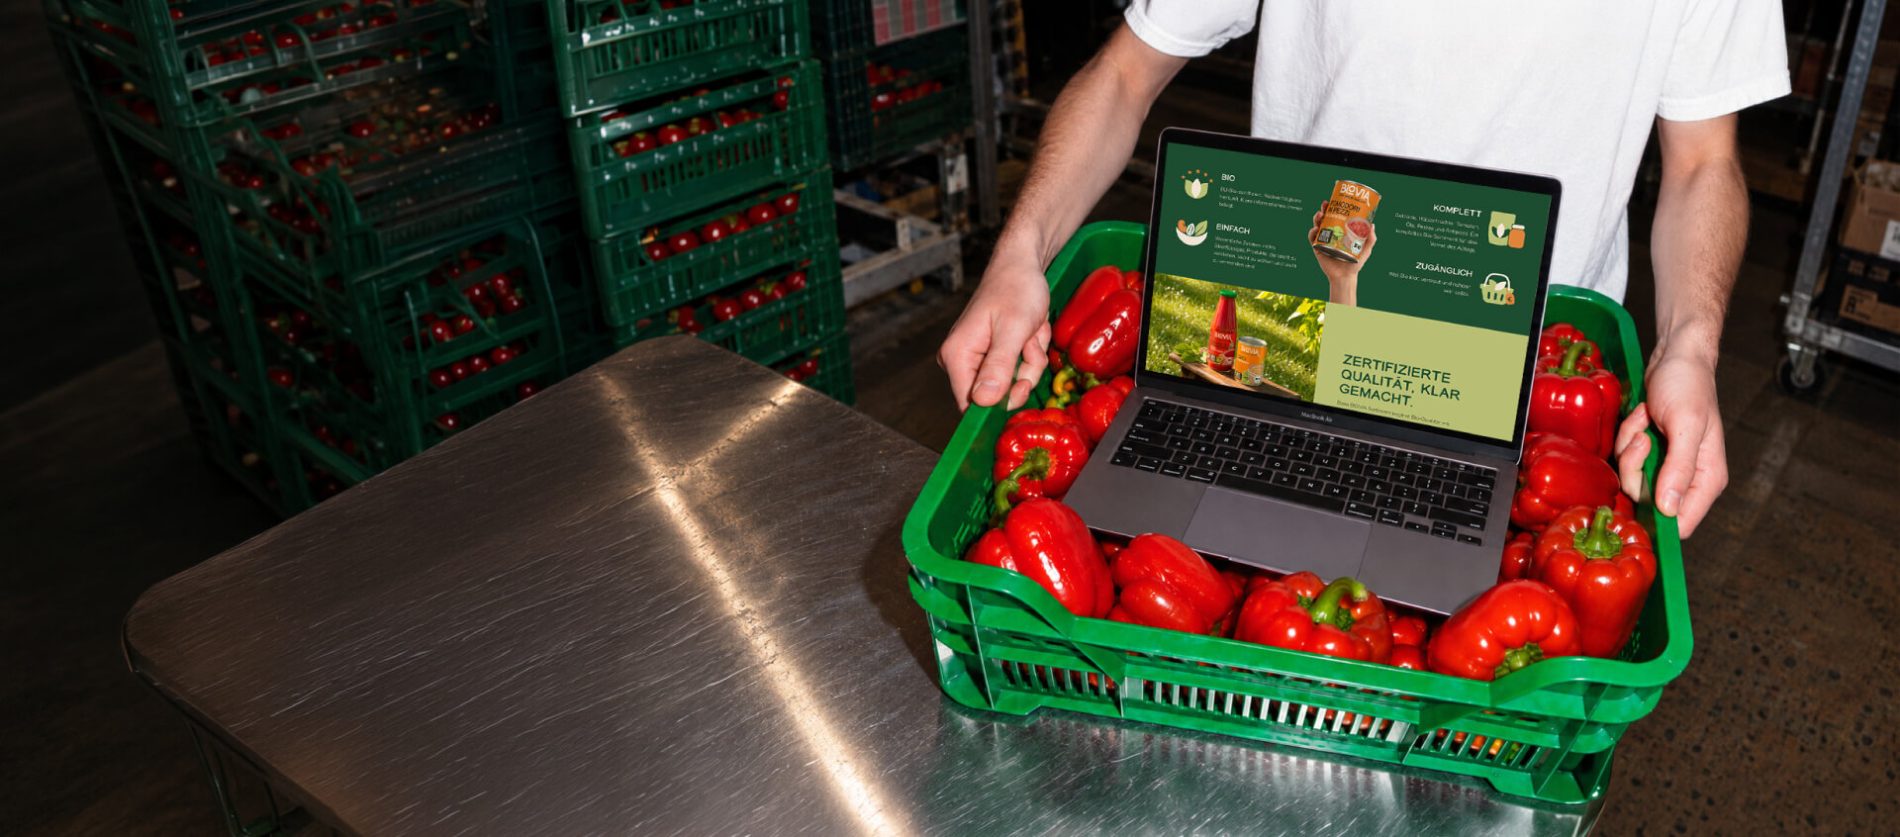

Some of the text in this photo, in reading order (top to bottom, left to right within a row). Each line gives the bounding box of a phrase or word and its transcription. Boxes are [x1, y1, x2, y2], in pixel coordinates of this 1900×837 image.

[1221, 174, 1236, 182] BIO
[1433, 204, 1482, 218] KOMPLETT
[1216, 223, 1250, 234] EINFACH
[1416, 262, 1473, 278] ZUGÄNGLICH
[1342, 354, 1451, 384] ZERTIFIZIERTE
[1339, 383, 1414, 408] GEMACHT.
[1420, 383, 1461, 401] KLAR
